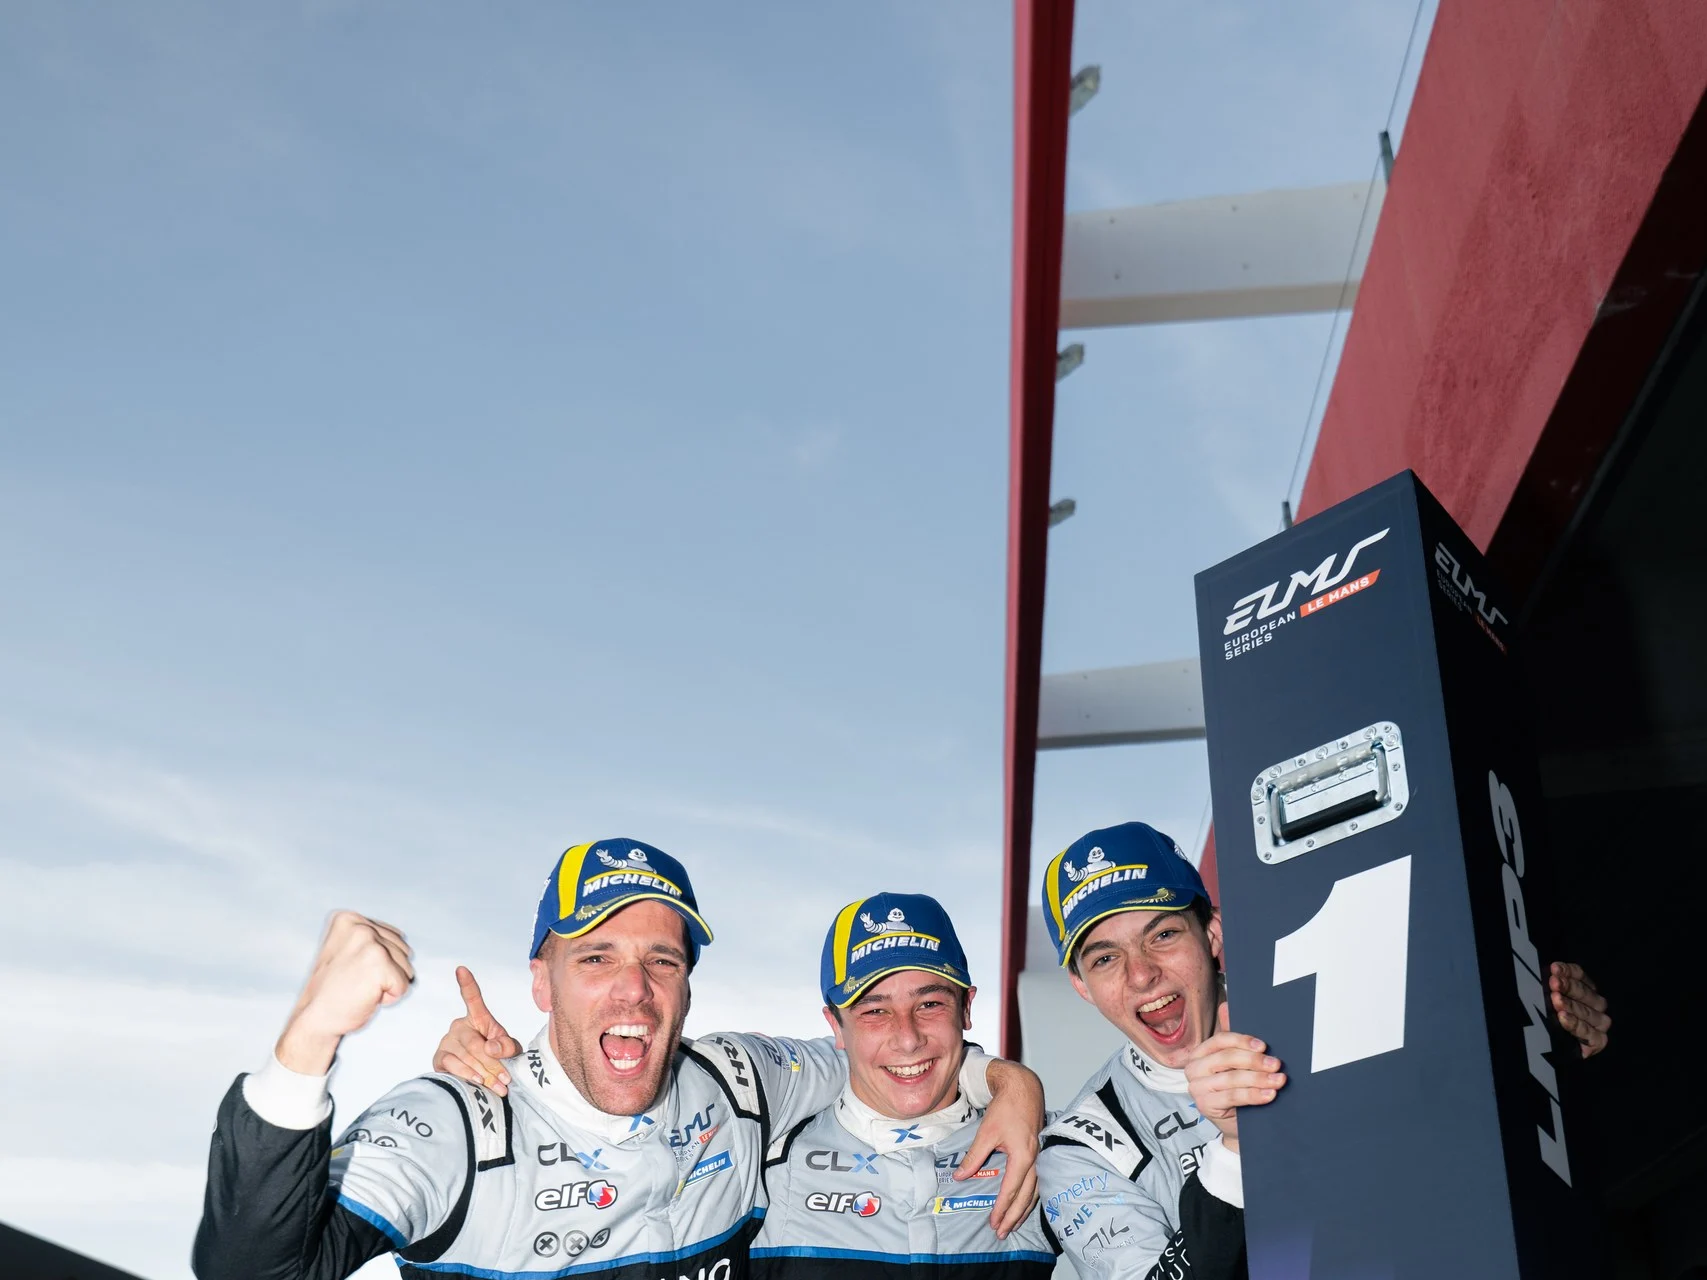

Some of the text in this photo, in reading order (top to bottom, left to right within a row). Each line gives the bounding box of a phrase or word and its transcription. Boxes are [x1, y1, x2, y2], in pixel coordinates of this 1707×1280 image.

[1223, 527, 1391, 636] ELMS
[1224, 576, 1371, 652] EUROPEAN LE MANS
[1225, 632, 1273, 661] SERIES
[582, 873, 683, 900] MICHELIN
[1062, 868, 1148, 920] MICHELIN
[851, 936, 940, 965] MICHELIN
[1272, 854, 1412, 1074] 1
[1488, 768, 1573, 1189] LMP3
[1062, 1115, 1126, 1152] HRX
[1154, 1102, 1206, 1140] CL
[537, 1141, 611, 1170] CLX
[805, 1151, 880, 1175] CLX
[535, 1181, 590, 1211] elf
[805, 1192, 854, 1214] elf
[953, 1199, 996, 1209] MICHELI
